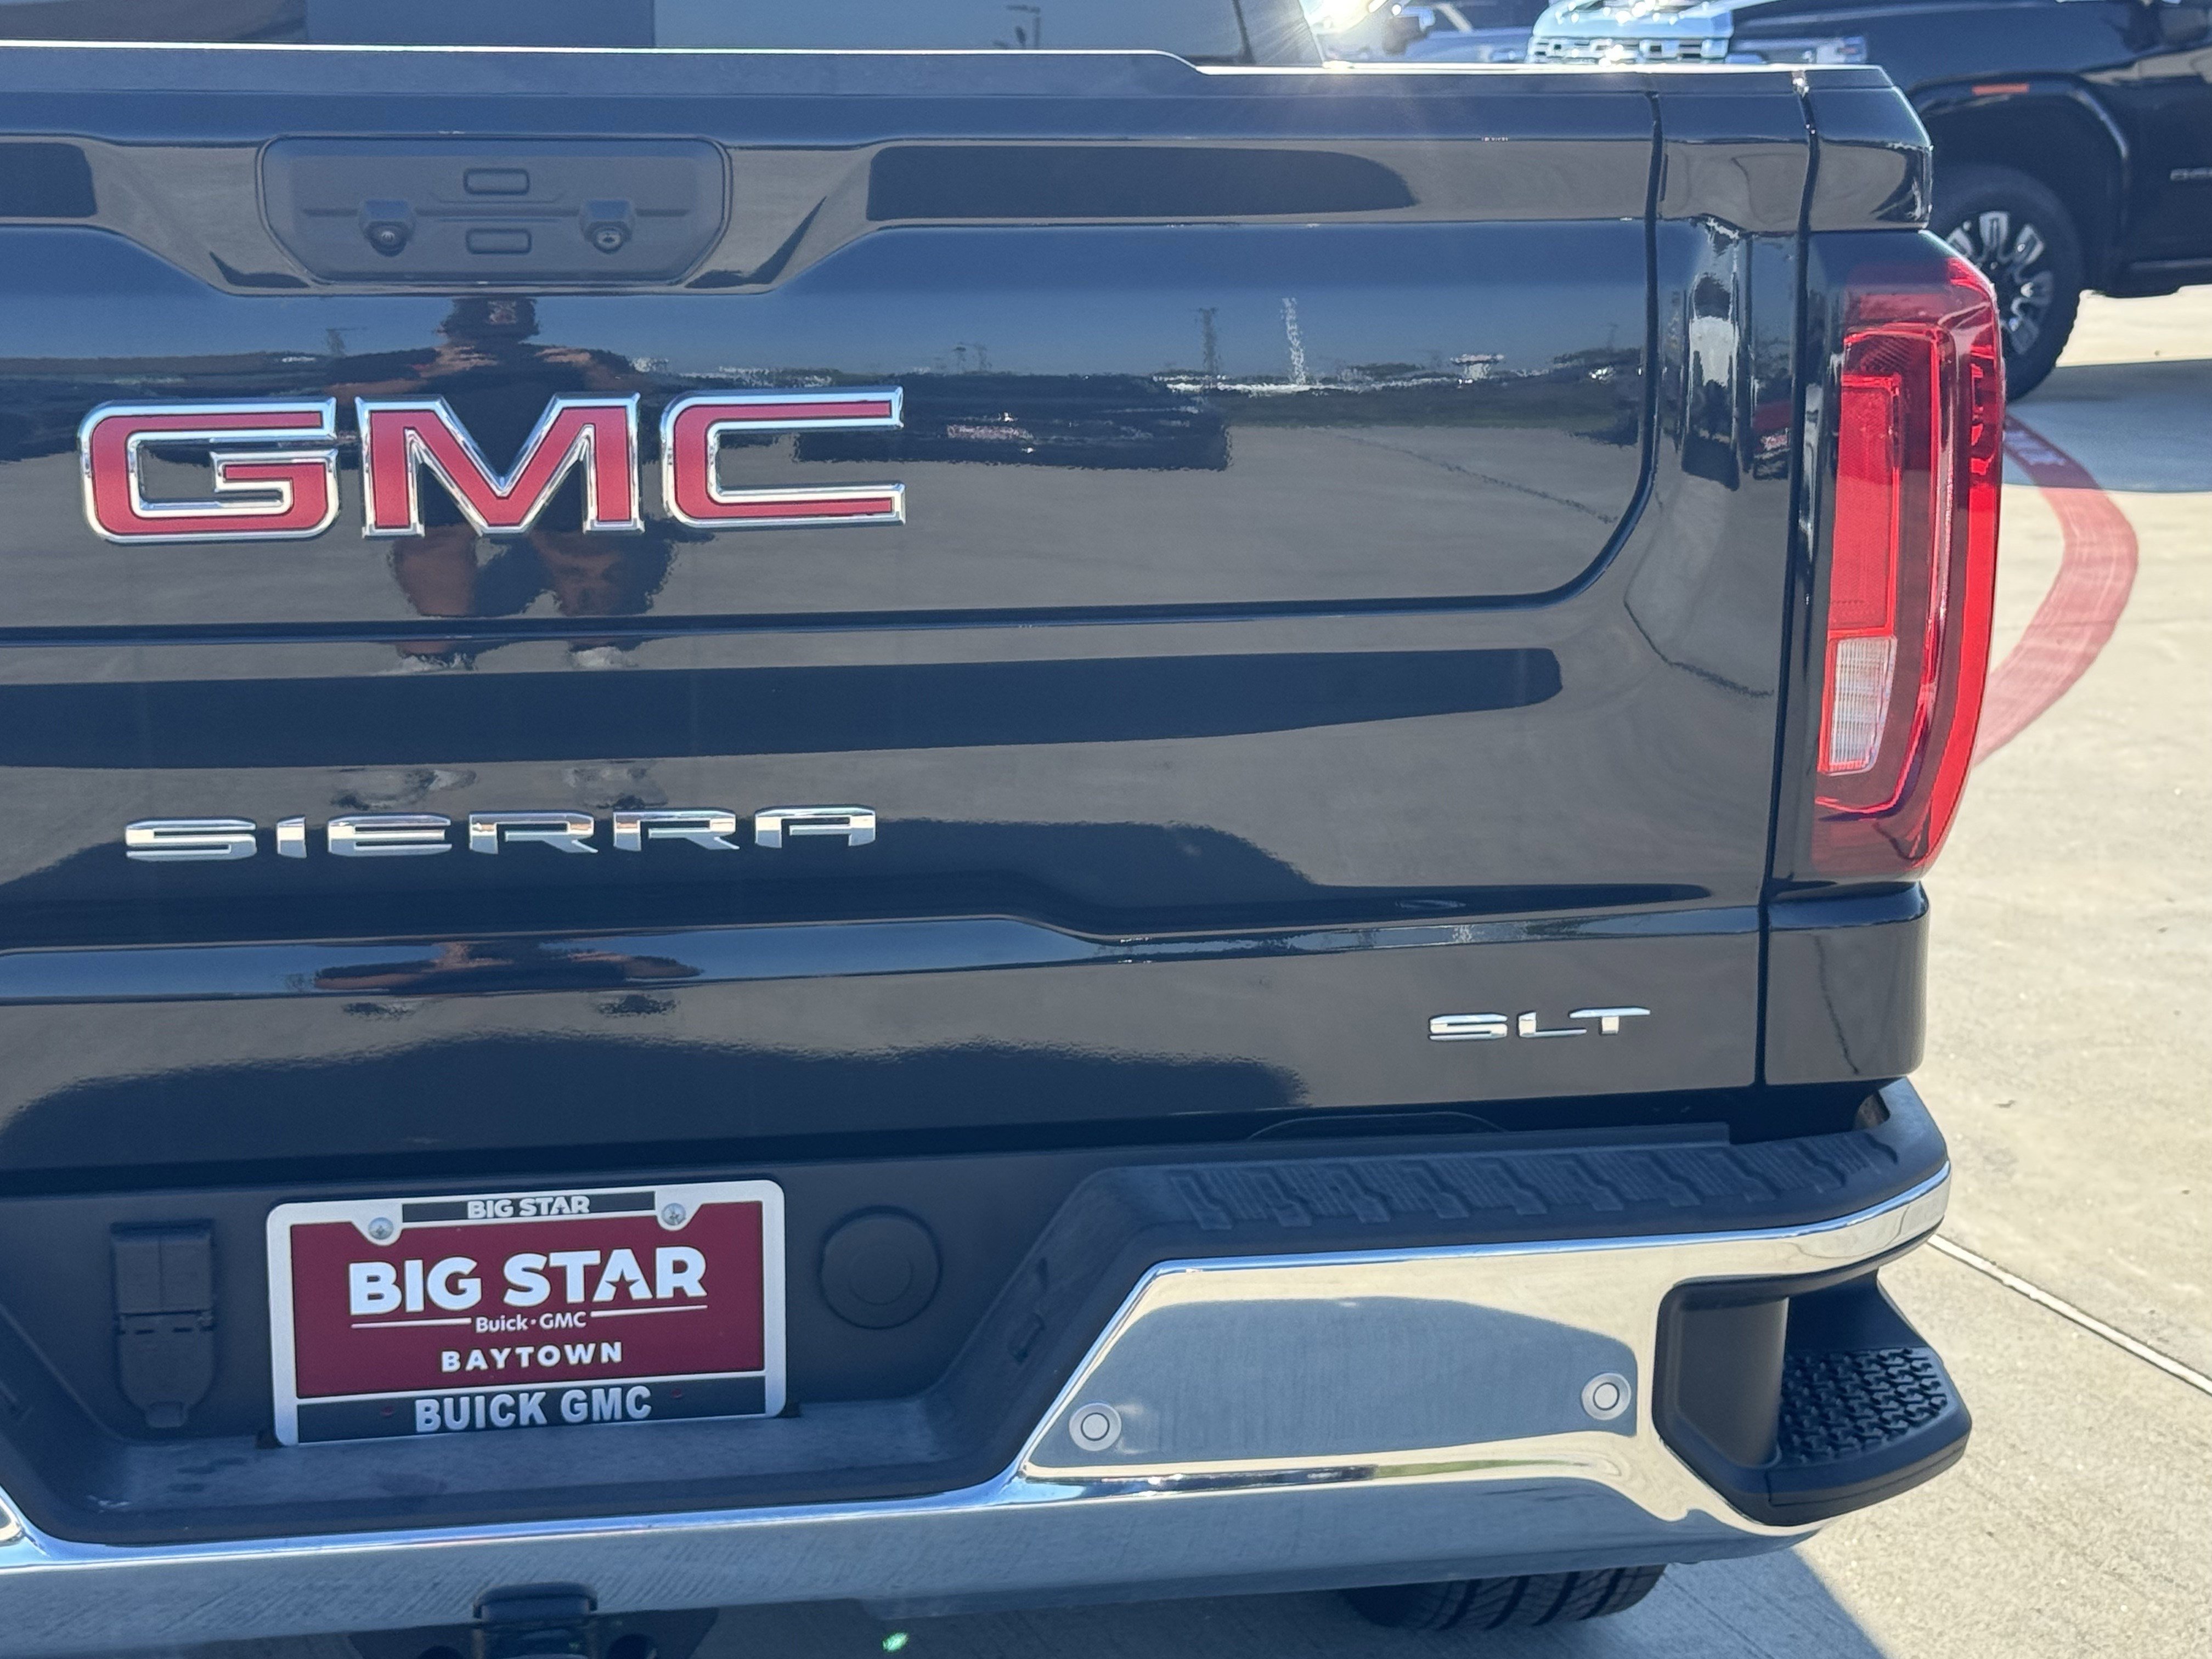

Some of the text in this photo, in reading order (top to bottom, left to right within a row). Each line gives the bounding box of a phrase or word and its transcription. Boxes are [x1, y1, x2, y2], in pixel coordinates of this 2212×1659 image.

[80, 386, 905, 542] GMC
[125, 804, 877, 861] SIERRA
[1429, 1006, 1651, 1041] SLT
[466, 1195, 591, 1219] BIG STAR
[348, 1245, 708, 1316] BIG STAR
[441, 1341, 623, 1373] BAYTOWN
[415, 1385, 653, 1434] BUICK GMC
